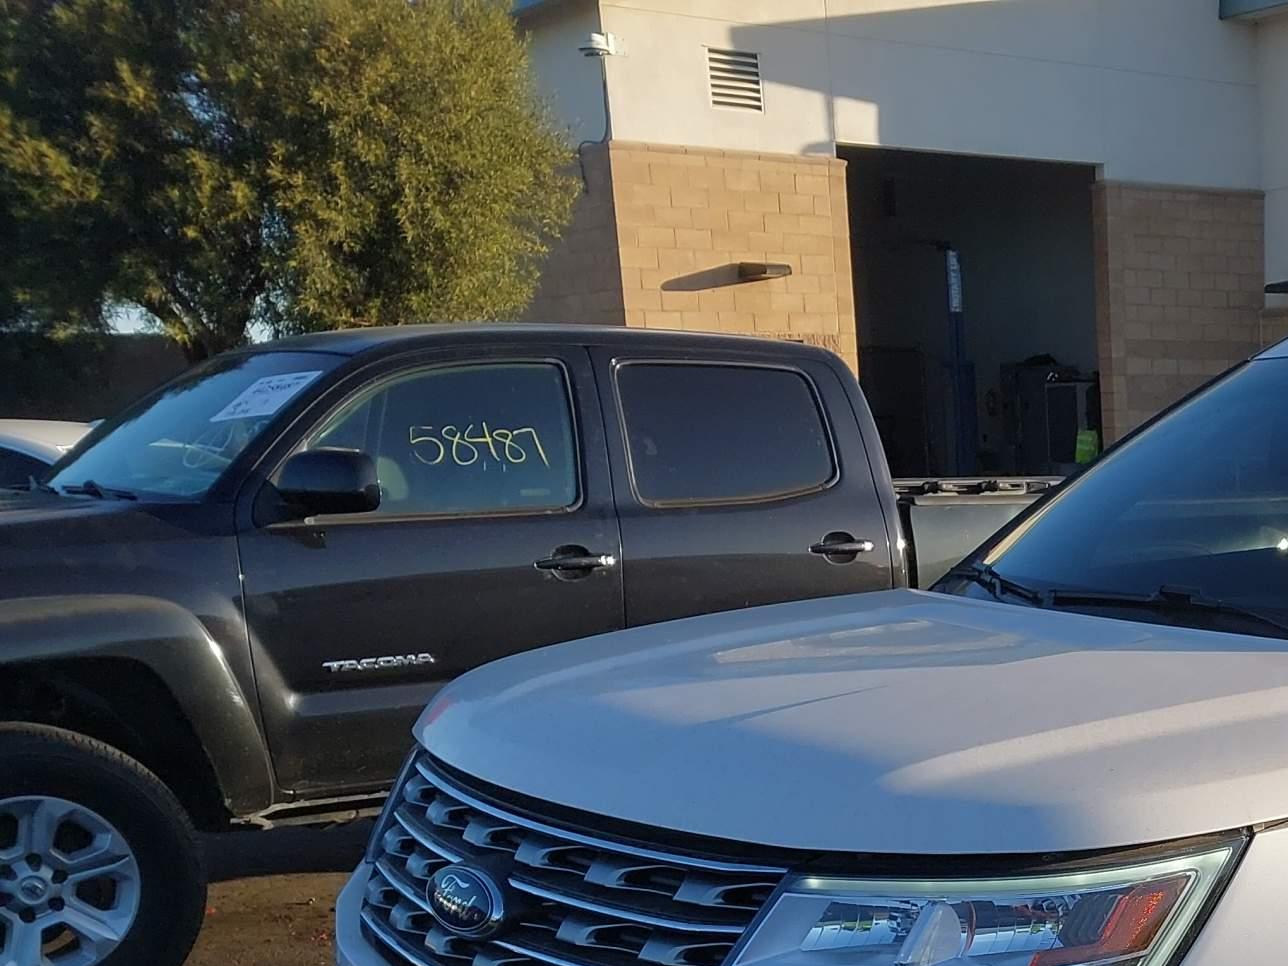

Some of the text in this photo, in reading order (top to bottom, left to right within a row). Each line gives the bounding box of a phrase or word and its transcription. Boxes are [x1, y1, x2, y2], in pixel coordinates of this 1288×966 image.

[409, 422, 550, 467] 58487
[322, 653, 434, 672] TACOMA
[440, 874, 480, 918] Ford
